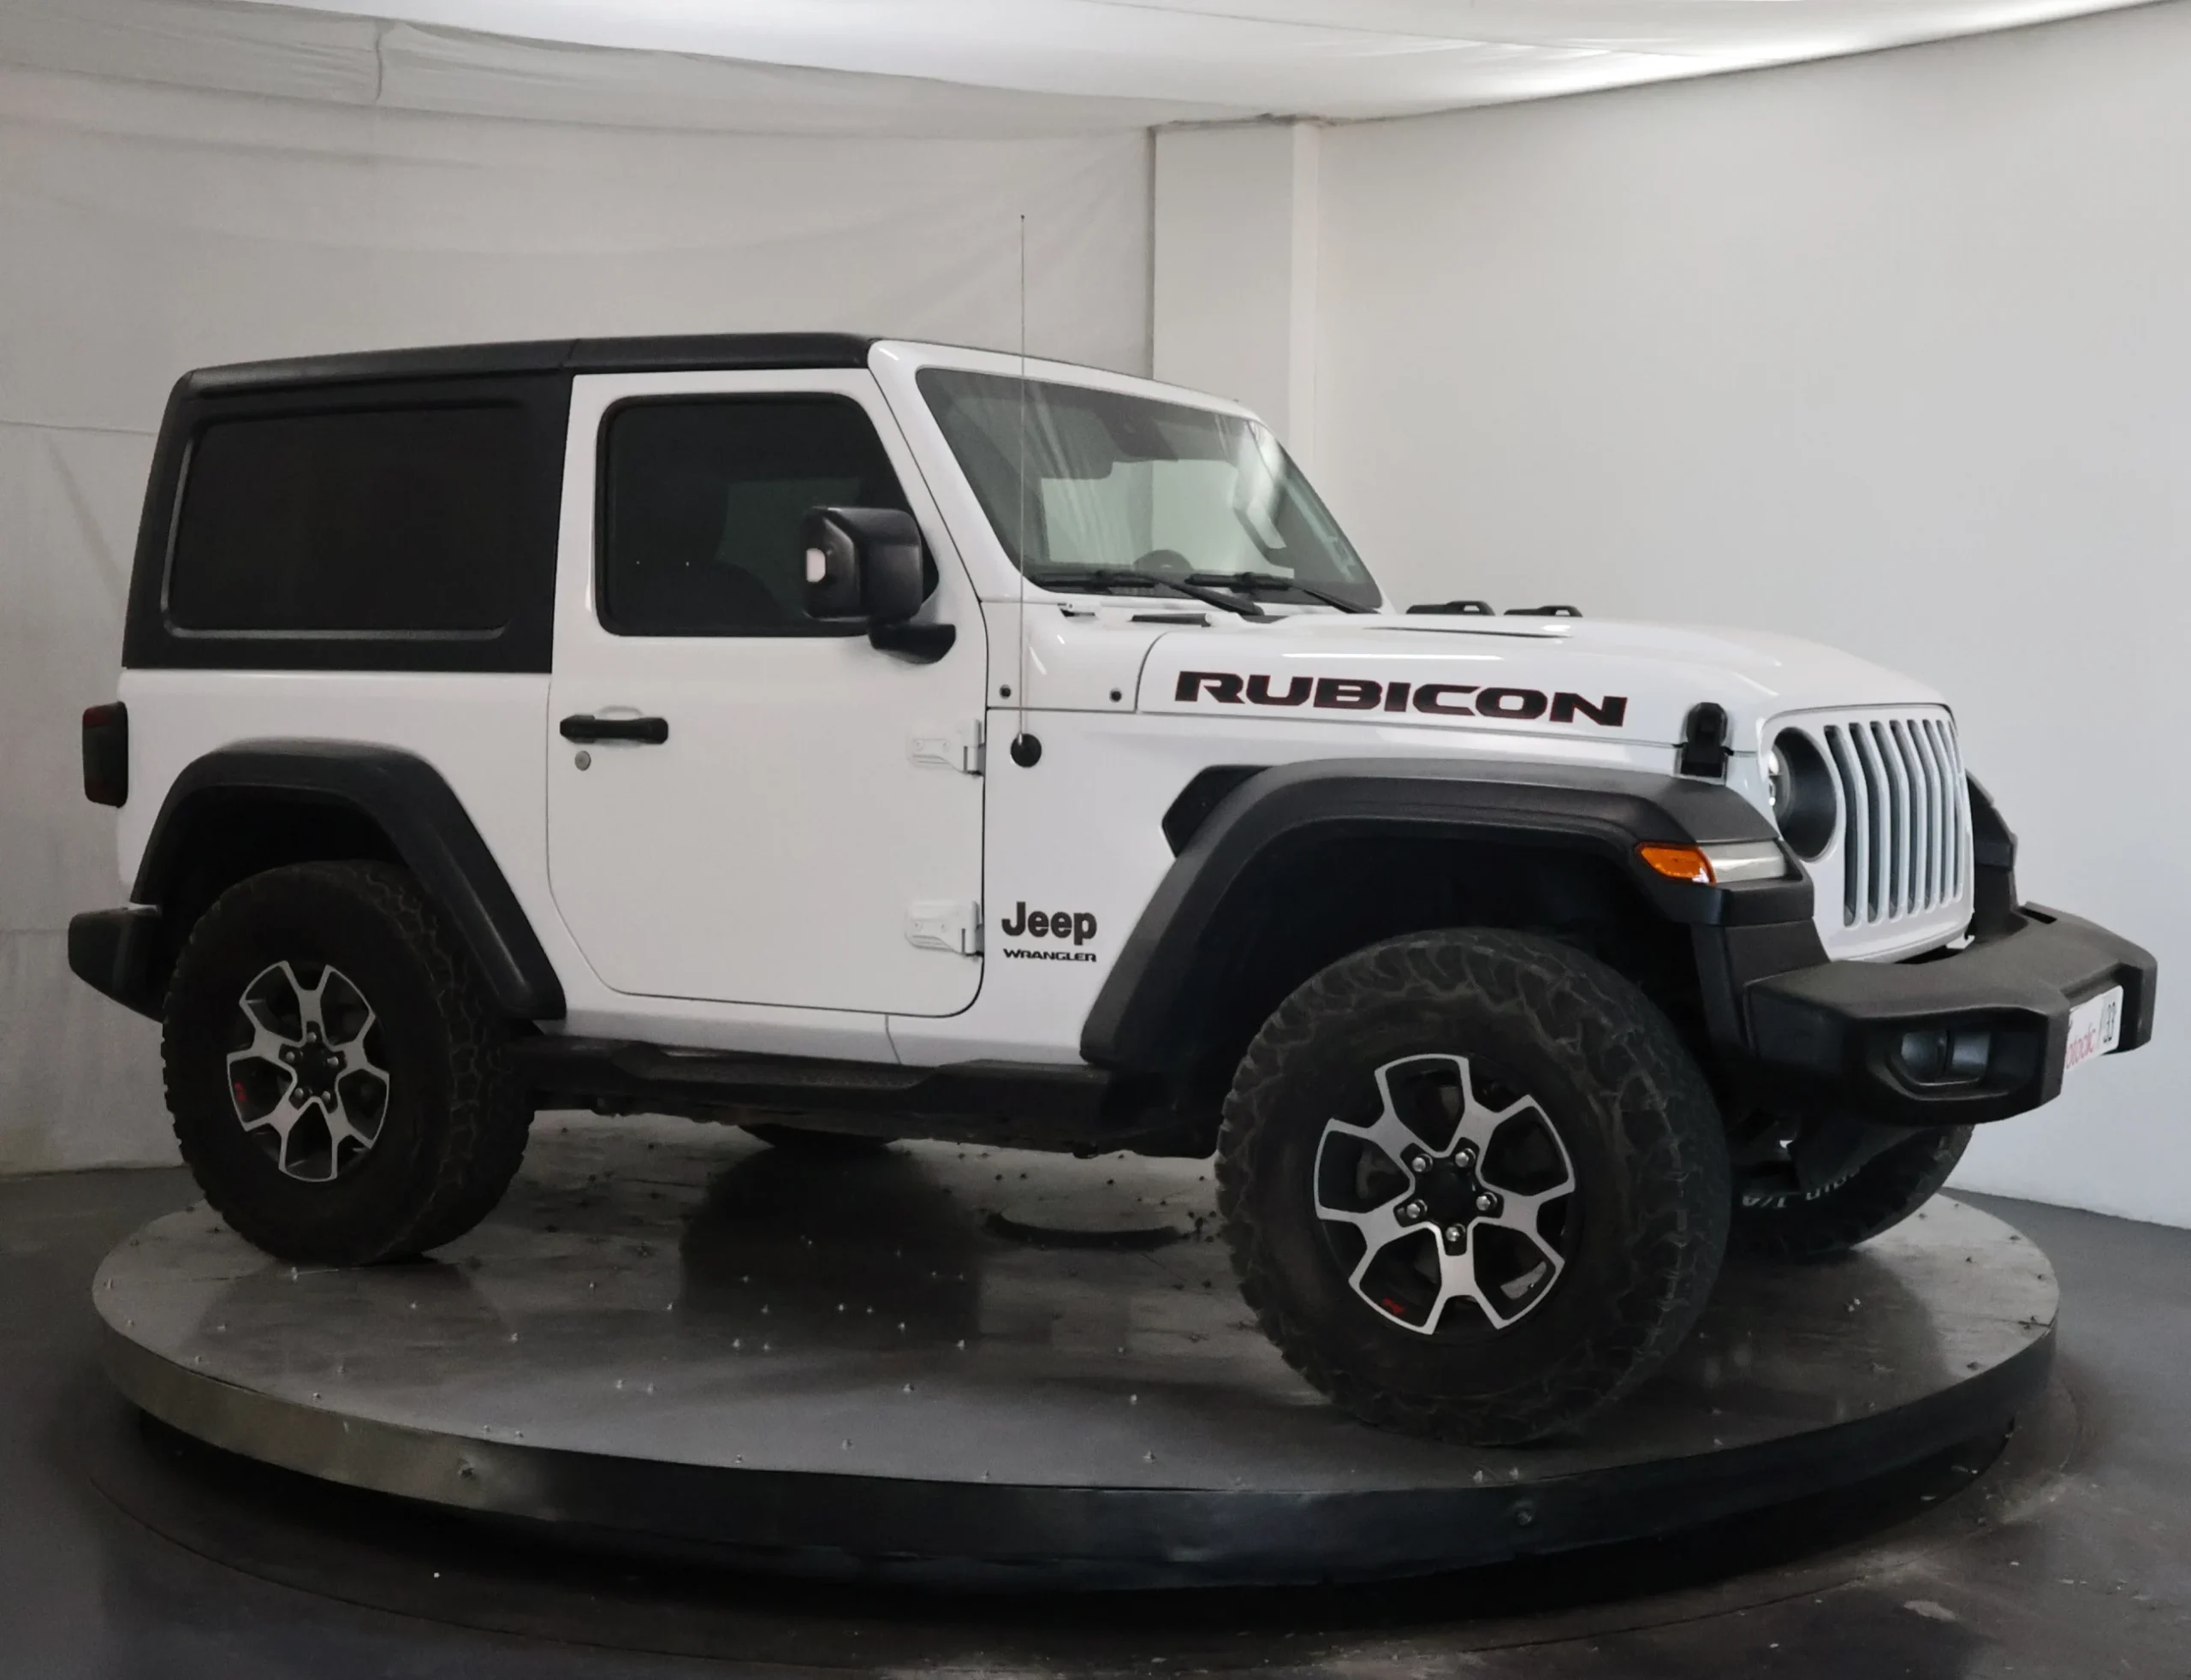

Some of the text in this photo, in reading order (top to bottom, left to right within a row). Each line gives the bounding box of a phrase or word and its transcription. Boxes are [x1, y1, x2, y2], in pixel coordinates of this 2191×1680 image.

[1174, 670, 1628, 727] RUBICON
[1001, 900, 1097, 946] Jeep
[1002, 948, 1097, 963] WRANGLER
